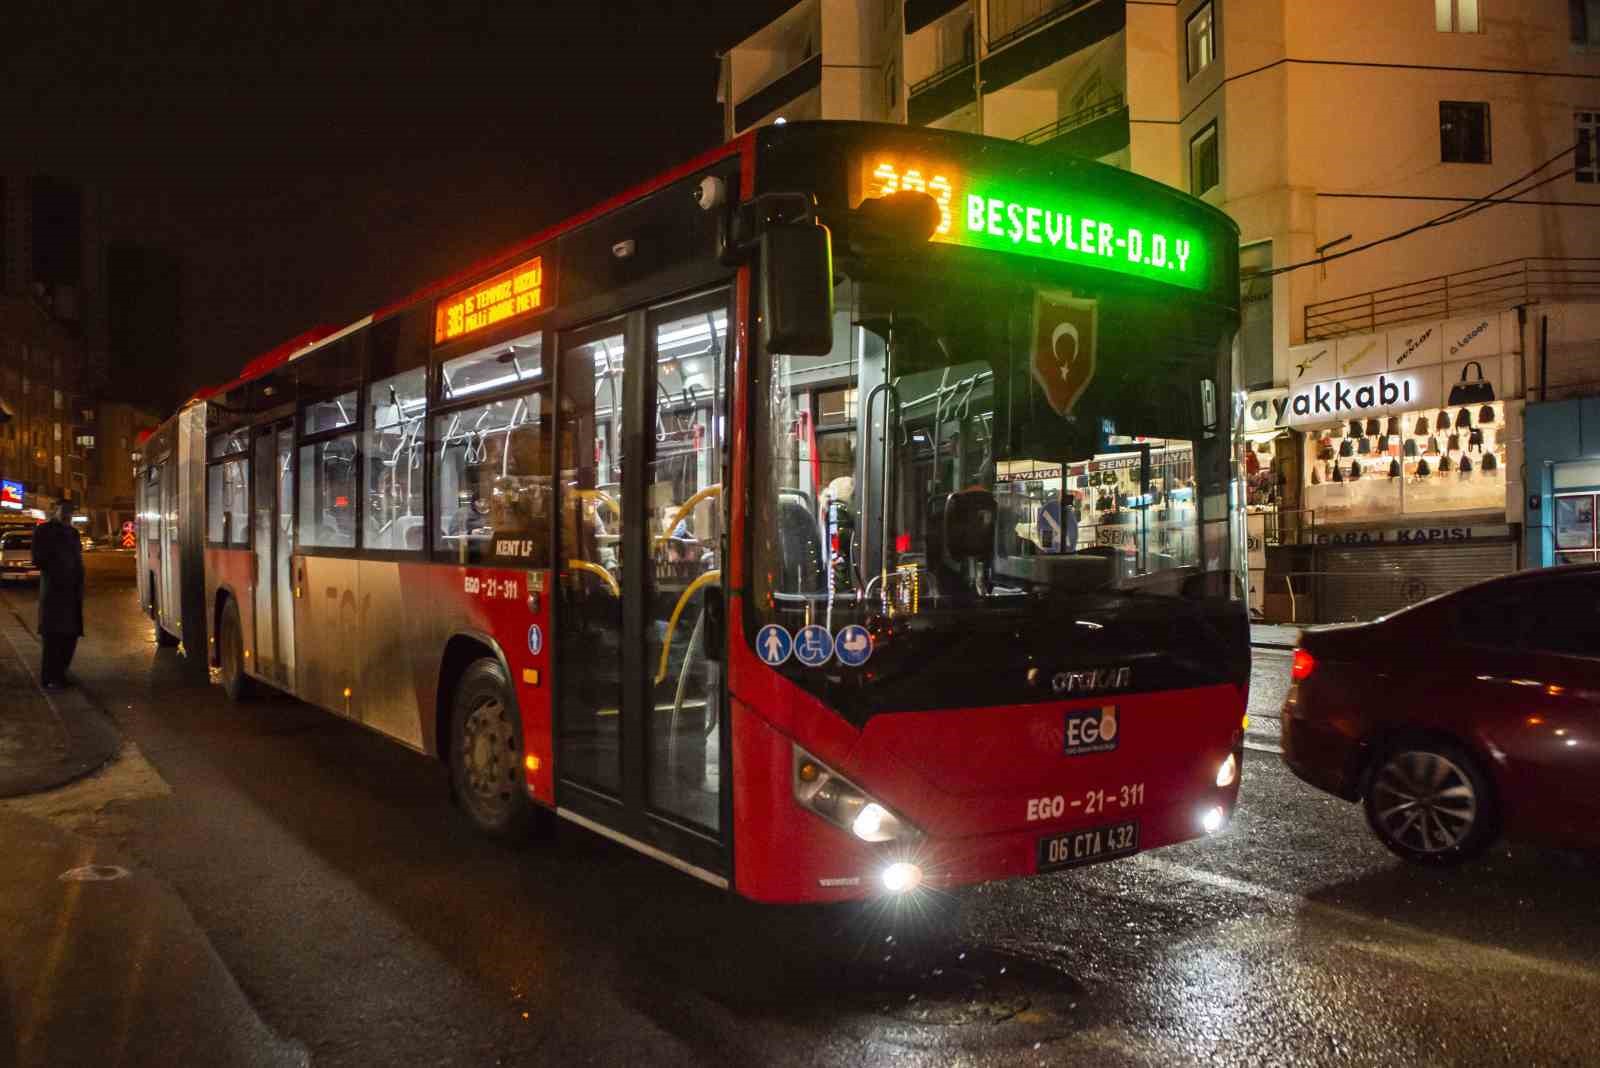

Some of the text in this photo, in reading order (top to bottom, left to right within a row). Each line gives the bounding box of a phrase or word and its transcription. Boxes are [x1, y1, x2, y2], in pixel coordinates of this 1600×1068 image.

[966, 193, 1191, 272] BEŞEVLER-D.D.Y
[1250, 375, 1412, 425] ayakkabı
[496, 540, 534, 557] KENT LF
[1067, 715, 1118, 746] EGO
[1048, 826, 1134, 863] 06 CTA 432
